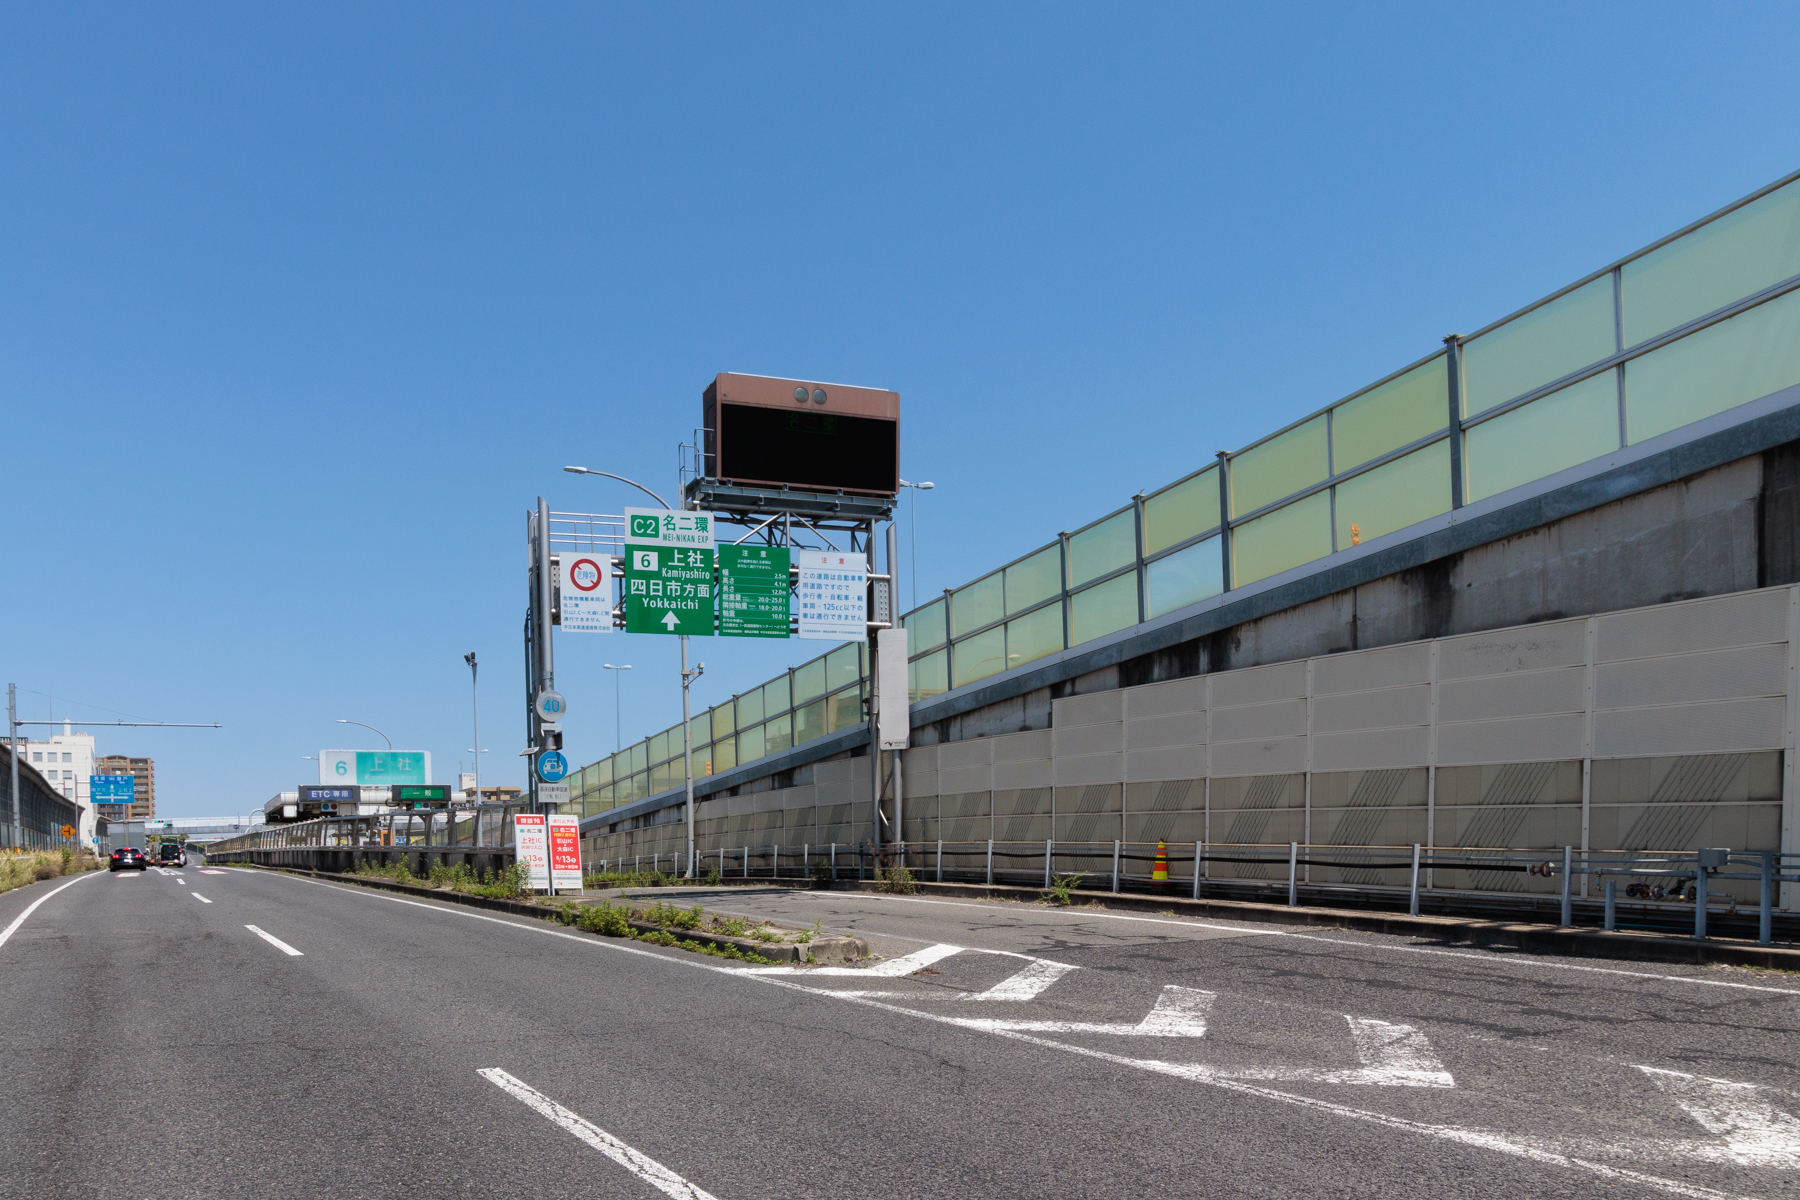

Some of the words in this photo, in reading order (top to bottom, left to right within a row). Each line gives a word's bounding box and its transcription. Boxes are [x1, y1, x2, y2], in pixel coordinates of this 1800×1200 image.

[788, 412, 836, 433] 名二環
[634, 518, 656, 534] C2
[663, 514, 709, 534] 名二環
[662, 533, 696, 543] MEI-NIKAN
[698, 535, 709, 544] EXP
[640, 554, 651, 568] 6
[668, 549, 705, 567] 上社
[577, 570, 597, 581] 危険物
[662, 567, 710, 581] Kamiyashiro
[803, 572, 864, 582] この道路は自動車専
[722, 576, 735, 585] 高さ
[631, 579, 710, 598] 四日市方面
[803, 582, 850, 591] 用道路ですので
[642, 598, 699, 610] Yokkaichi
[803, 612, 864, 622] 車は通行できません
[543, 699, 560, 713] 40
[335, 761, 348, 776] 6
[370, 756, 412, 772] 上社
[364, 774, 418, 782] Kamiyashiro
[311, 790, 330, 799] ETC
[333, 789, 349, 798] 専用
[413, 789, 432, 797] 一般
